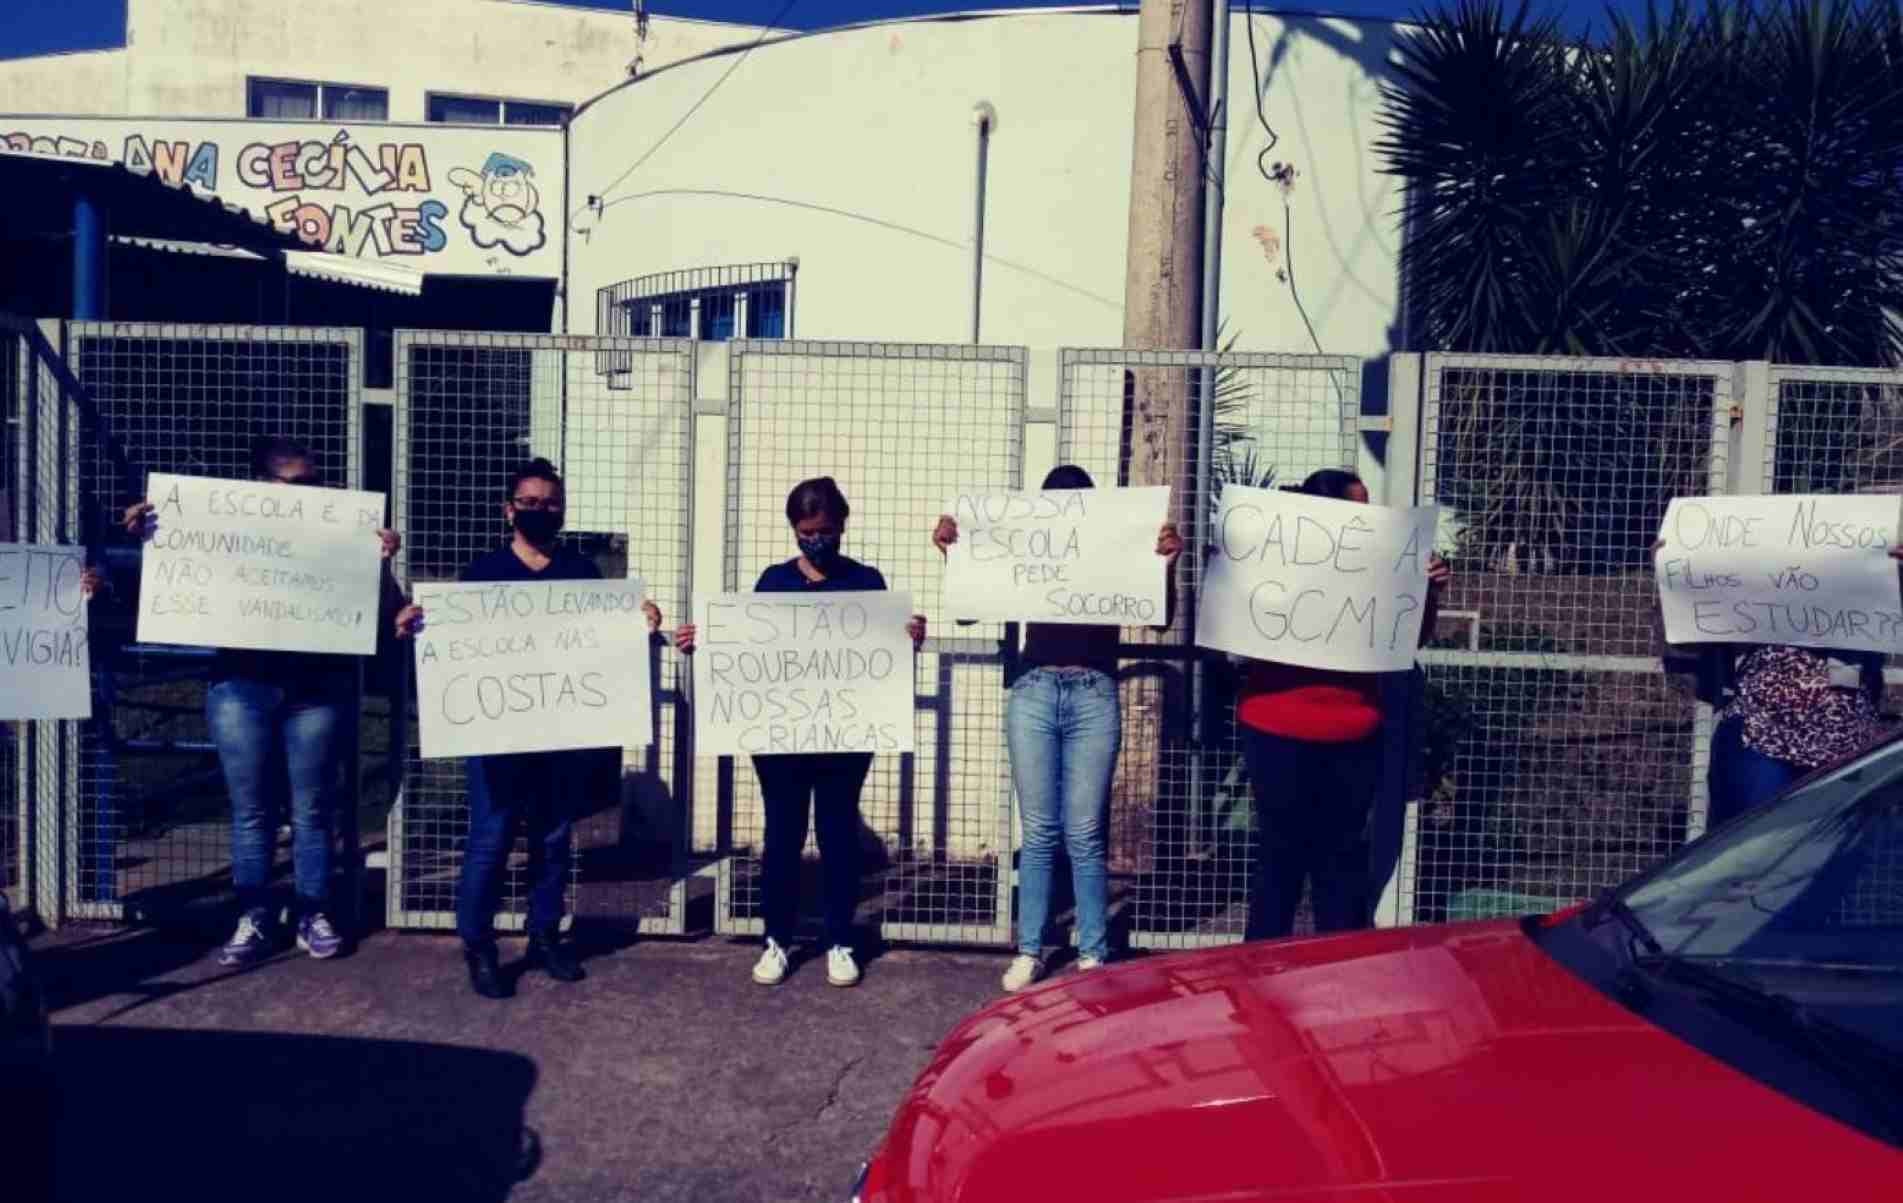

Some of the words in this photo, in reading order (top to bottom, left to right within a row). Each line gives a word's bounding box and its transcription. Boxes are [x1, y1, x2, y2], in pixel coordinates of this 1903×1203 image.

[124, 134, 219, 191] ANA
[237, 129, 430, 195] CECÍLIA
[265, 195, 448, 257] FONTES
[161, 484, 183, 514] A
[208, 490, 303, 520] ESCOLA
[956, 492, 1087, 523] NOSSA
[151, 529, 293, 558] COMUNIDADE
[969, 526, 1081, 560] ESCOLA
[1223, 503, 1375, 573] CADÊ
[1393, 526, 1420, 573] A
[154, 557, 213, 586] NÃO
[1013, 563, 1071, 586] PEDE
[1768, 566, 1820, 592] VÃO
[151, 595, 210, 616] ESSE
[419, 584, 535, 626] ESTÃO
[546, 584, 636, 615] LEVANDO
[706, 601, 868, 644] ESTÃO
[1045, 587, 1156, 621] SOCORRO
[1250, 580, 1420, 651] GCM?
[422, 641, 438, 664] A
[449, 633, 537, 661] ESCOLA
[555, 626, 599, 650] NAS
[709, 647, 894, 686] ROUBANDO
[442, 671, 608, 725] COSTAS
[709, 687, 858, 724] NOSSAS
